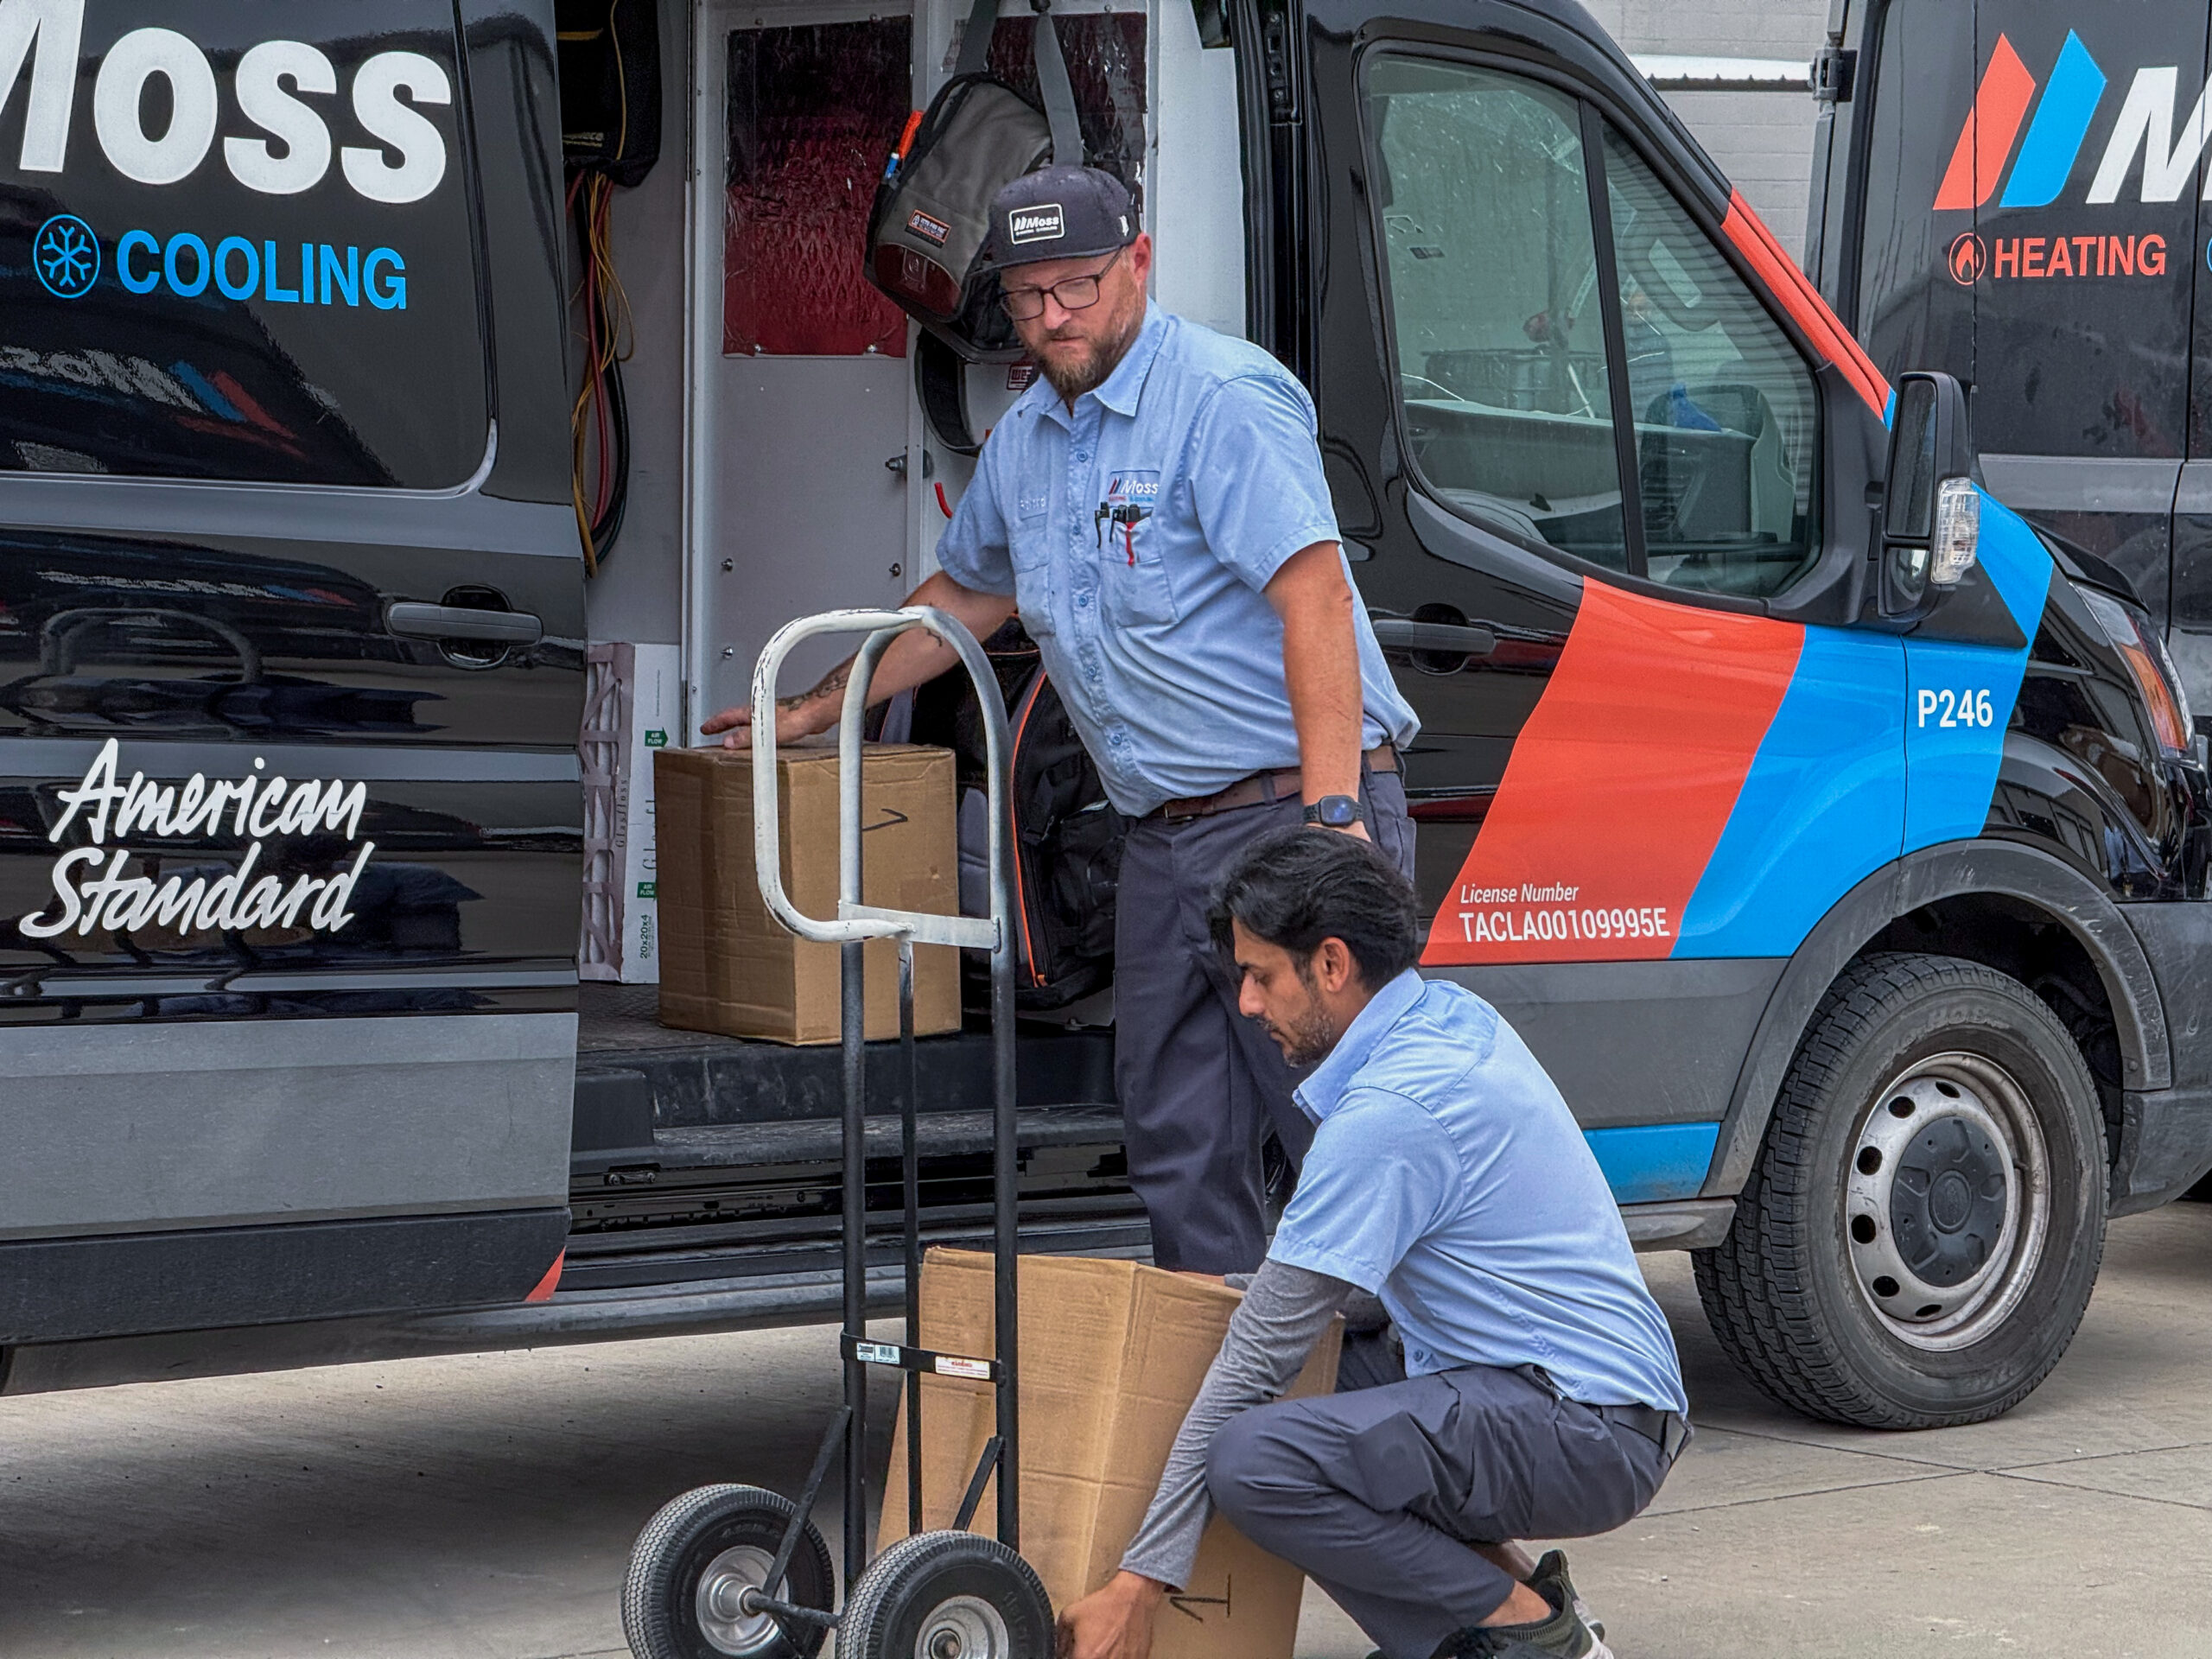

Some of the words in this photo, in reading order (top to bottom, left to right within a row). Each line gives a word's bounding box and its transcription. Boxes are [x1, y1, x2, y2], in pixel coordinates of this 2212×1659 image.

[1026, 216, 1060, 229] Moss
[117, 230, 407, 310] COOLING
[1994, 234, 2166, 278] HEATING
[1121, 480, 1159, 495] Moss
[1916, 689, 1994, 728] P246
[48, 737, 367, 845] American
[18, 841, 376, 939] Standard
[1460, 883, 1517, 904] License
[1521, 881, 1580, 903] Number
[639, 914, 649, 959] 20x20x4
[1459, 907, 1671, 943] TACLA00109995E
